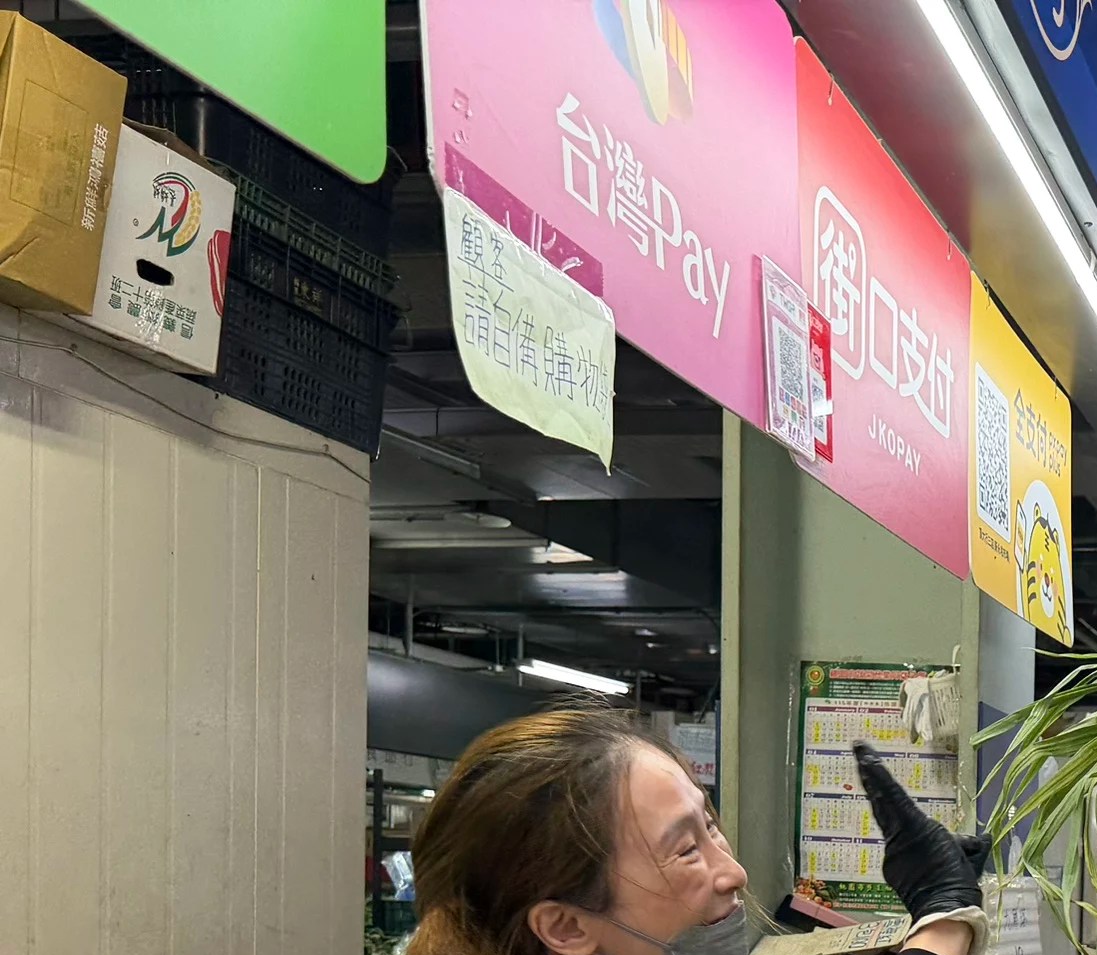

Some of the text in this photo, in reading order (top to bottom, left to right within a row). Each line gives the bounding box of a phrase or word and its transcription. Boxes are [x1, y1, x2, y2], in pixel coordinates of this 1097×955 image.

[556, 92, 731, 339] 台灣Pay
[814, 188, 954, 439] 街口支付
[868, 414, 921, 476] JKOPAY
[1014, 387, 1048, 468] 全支付
